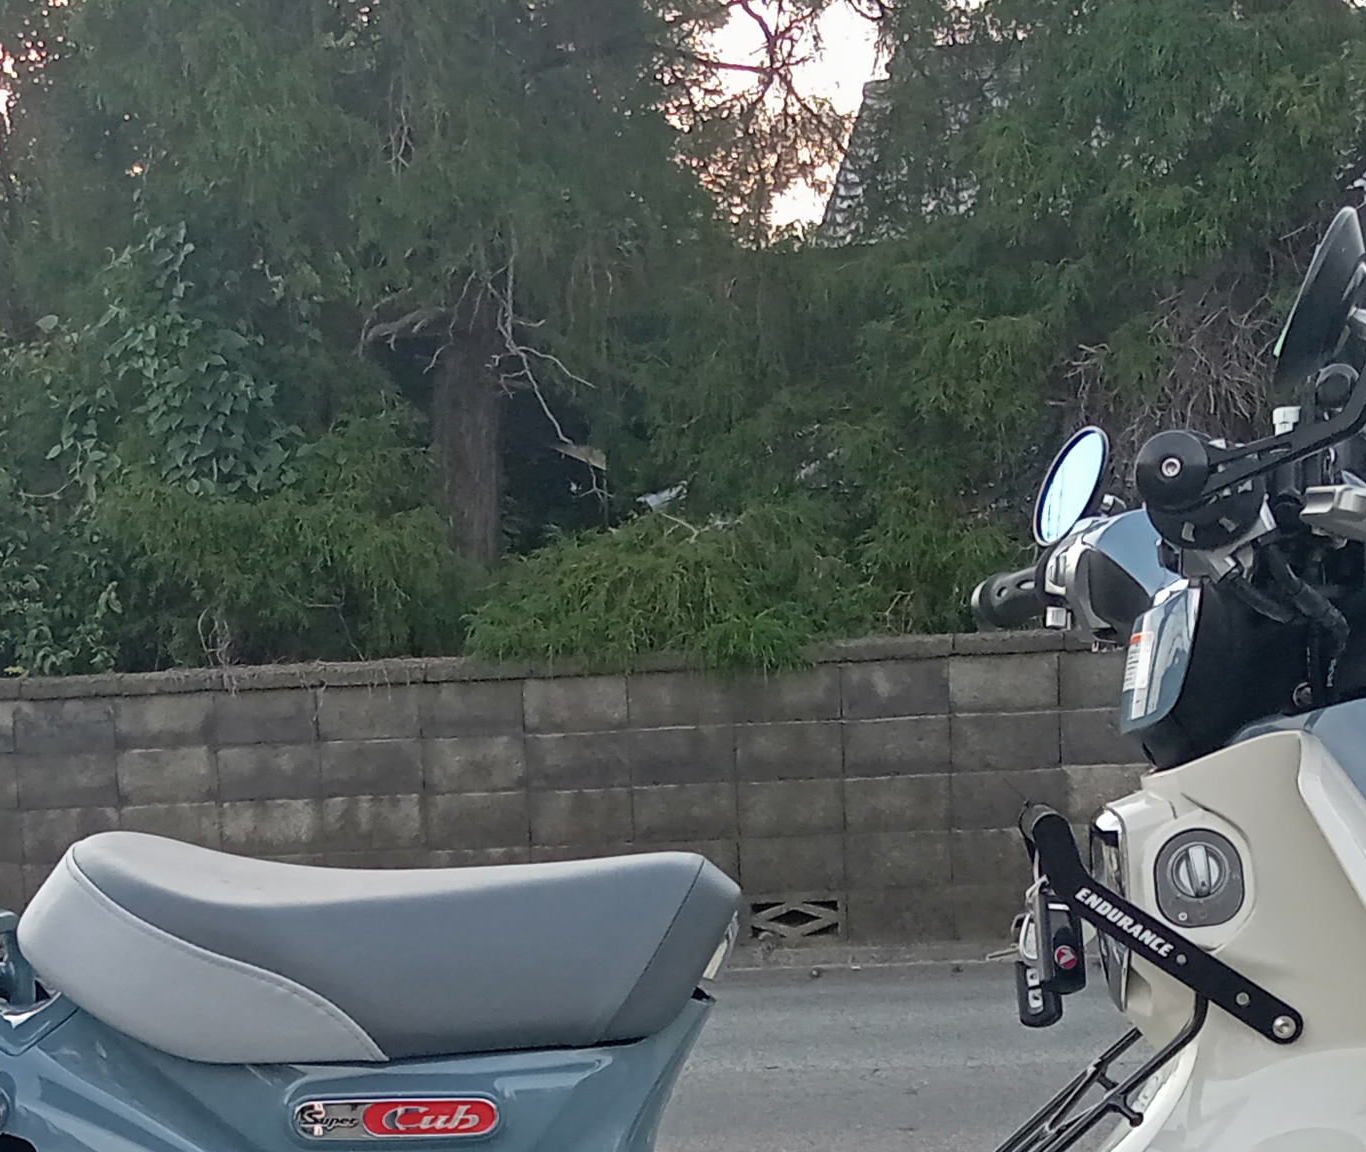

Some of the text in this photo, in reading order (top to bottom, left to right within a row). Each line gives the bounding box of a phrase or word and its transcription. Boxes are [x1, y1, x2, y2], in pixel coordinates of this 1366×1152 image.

[1075, 888, 1175, 958] ENDURANCE
[300, 1104, 480, 1131] Super Cub
